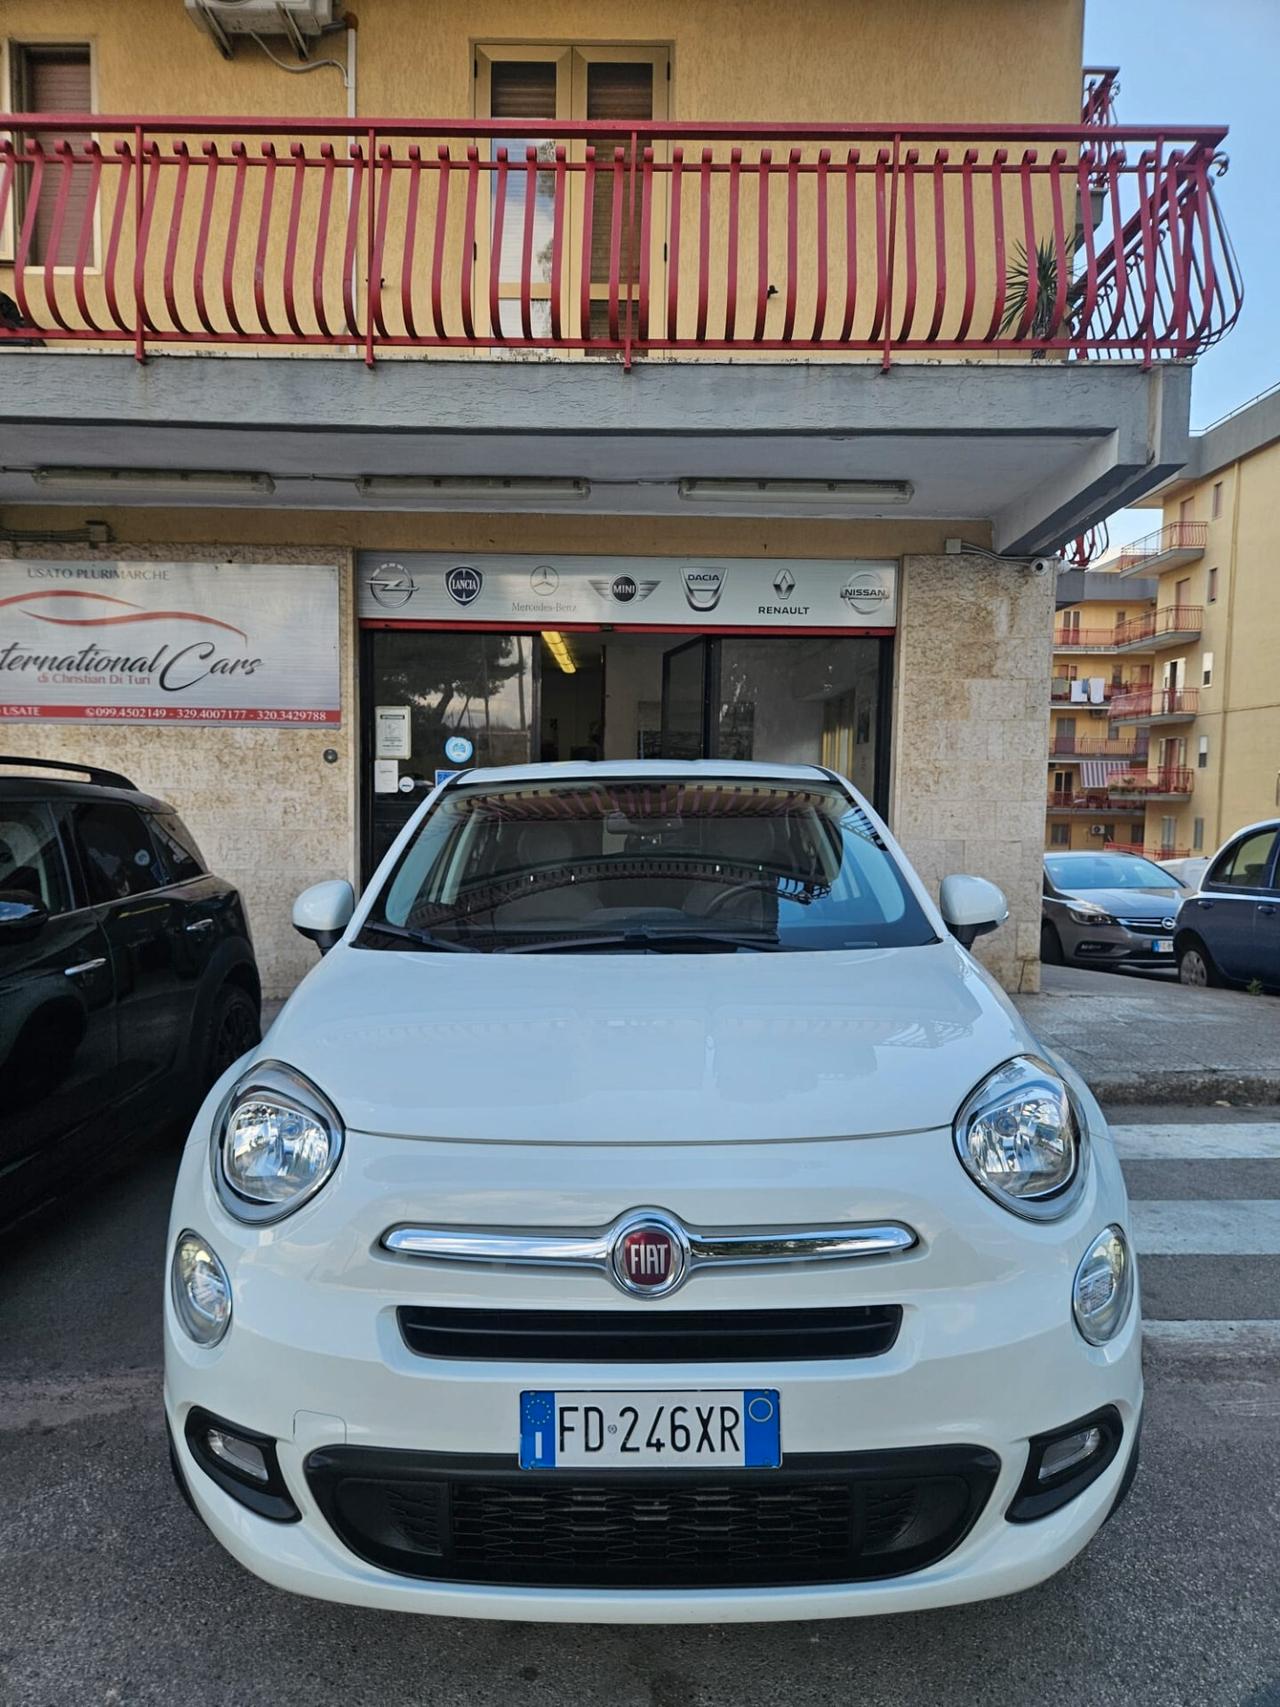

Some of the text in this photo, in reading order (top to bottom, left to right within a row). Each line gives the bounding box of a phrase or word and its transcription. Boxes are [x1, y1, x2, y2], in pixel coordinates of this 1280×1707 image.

[27, 568, 170, 580] USATO PLURIMARCHE
[688, 574, 720, 582] DACIA
[452, 579, 477, 591] LANCIA
[612, 584, 636, 595] MINI
[844, 588, 886, 598] NISSAN
[511, 602, 577, 613] Mercedes-Benz
[758, 606, 810, 615] RENAULT
[159, 641, 264, 692] Cars
[37, 674, 49, 683] di
[52, 674, 106, 684] Christian
[109, 674, 124, 684] Di
[3, 706, 40, 716] USATE
[176, 709, 247, 719] 329.4007177
[256, 710, 327, 721] 320.3429788
[630, 1244, 668, 1275] FIAT
